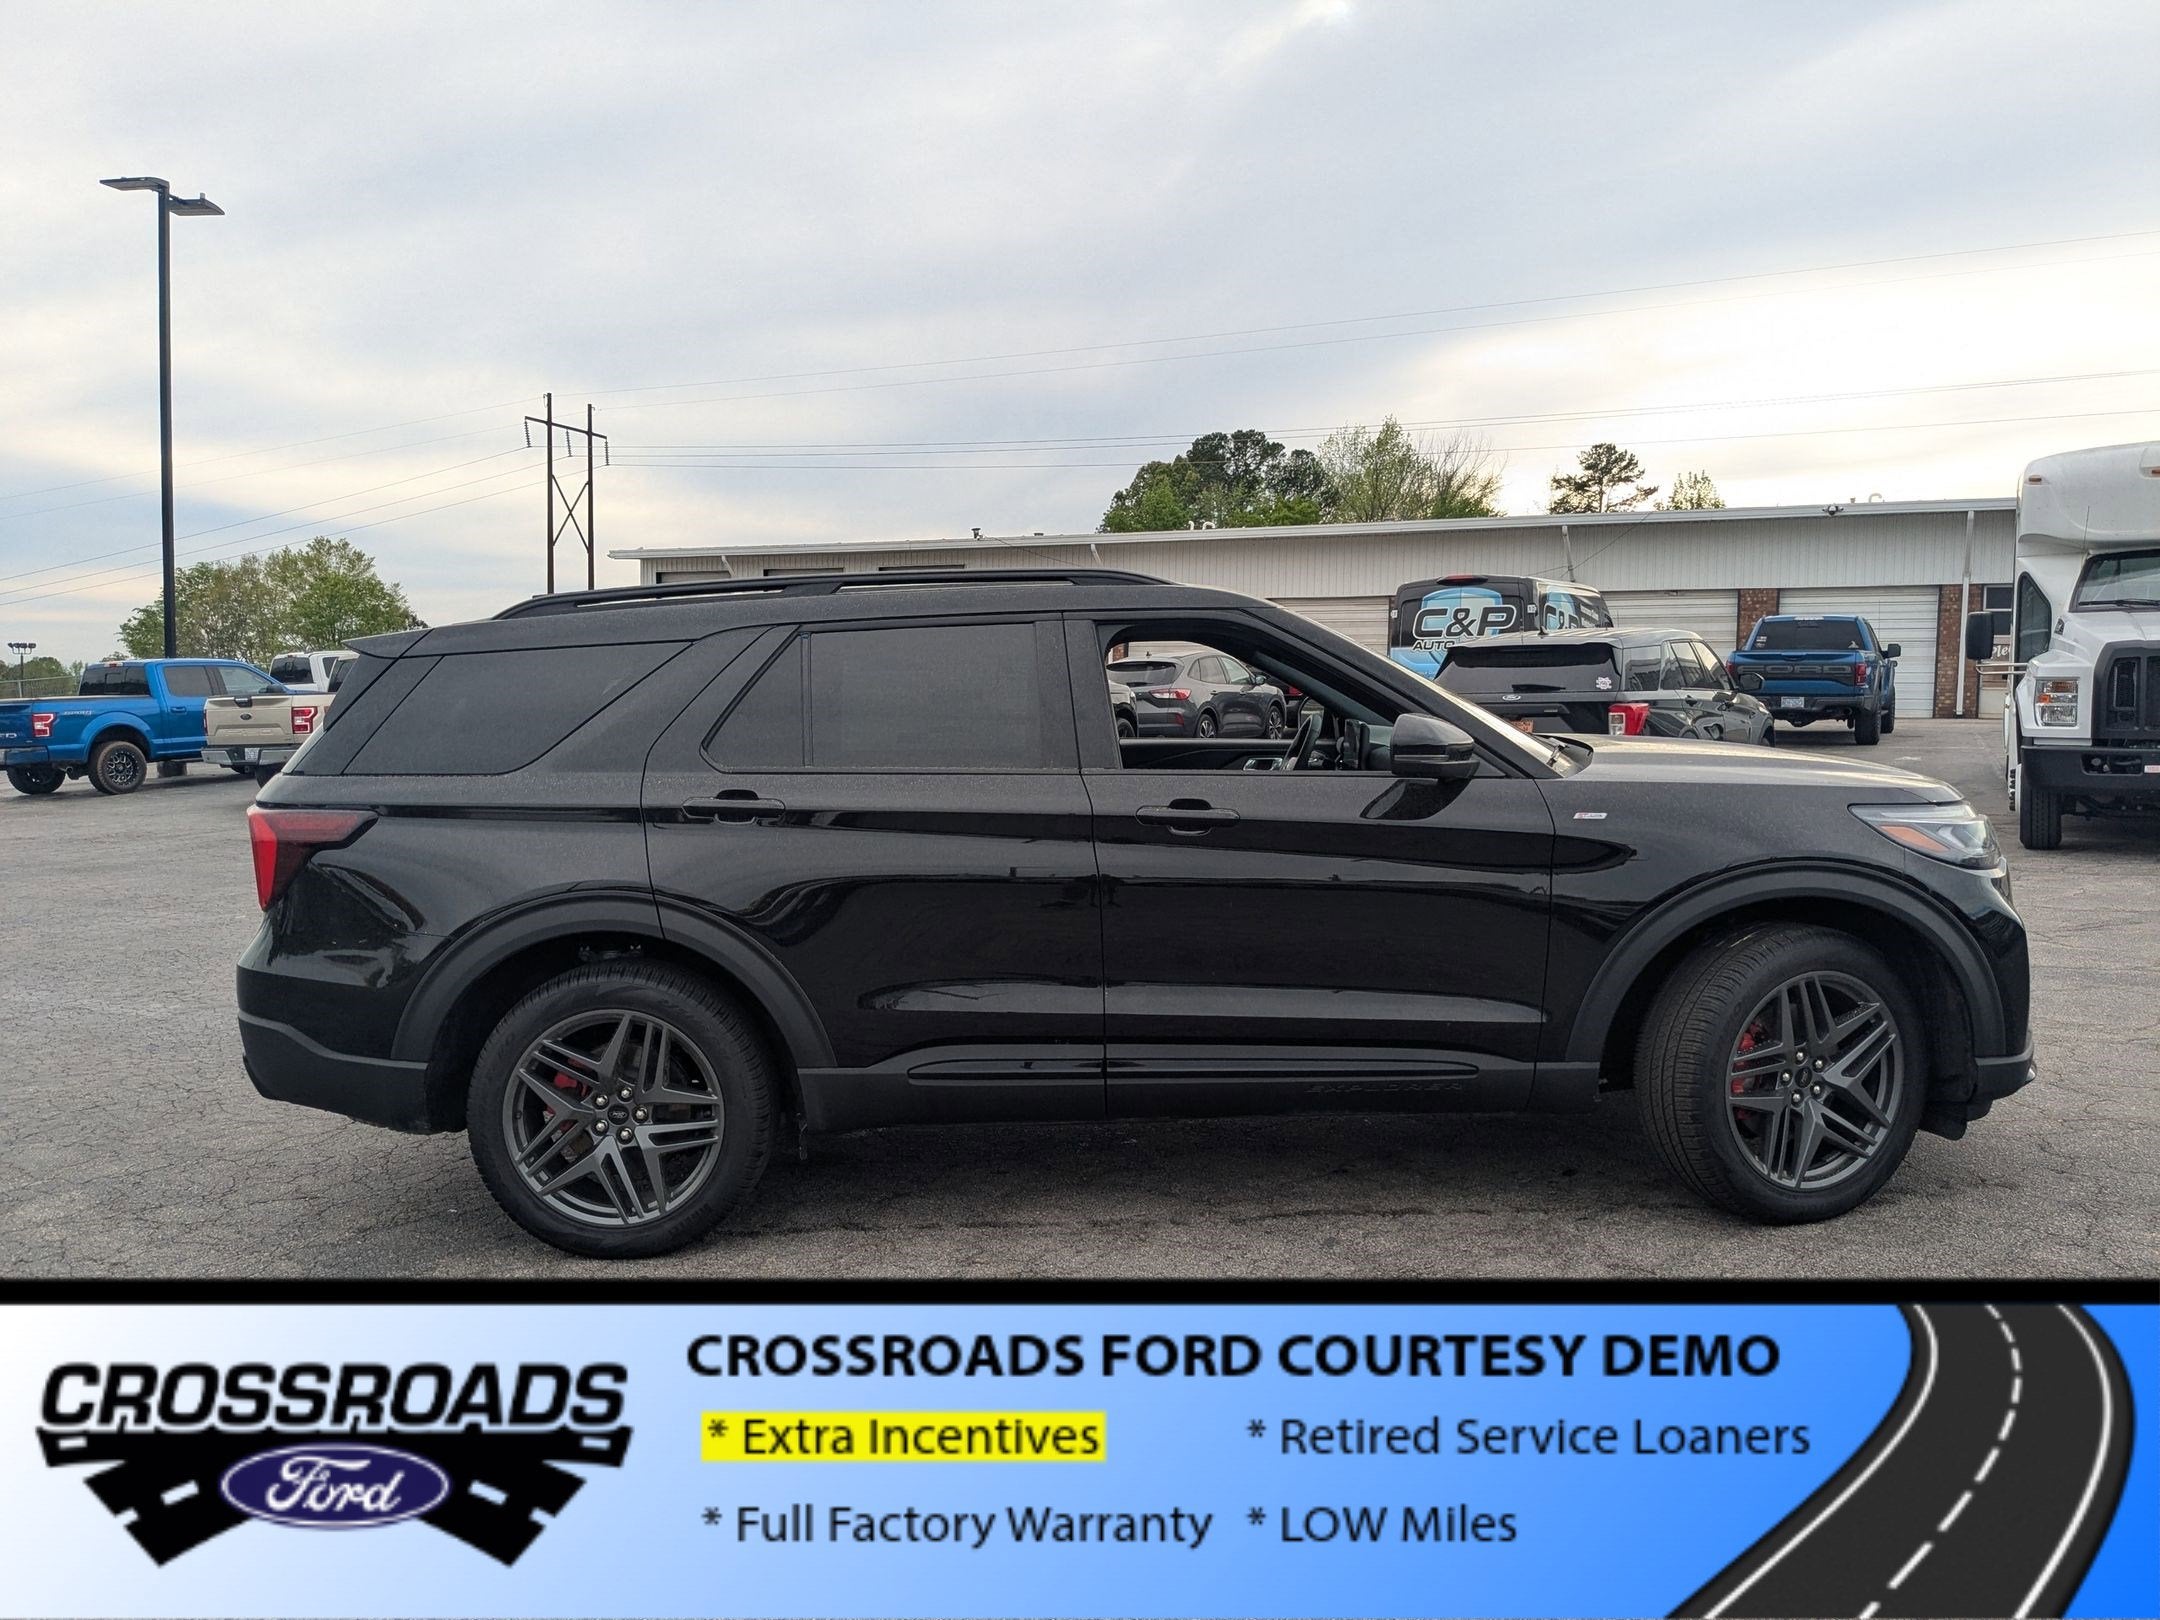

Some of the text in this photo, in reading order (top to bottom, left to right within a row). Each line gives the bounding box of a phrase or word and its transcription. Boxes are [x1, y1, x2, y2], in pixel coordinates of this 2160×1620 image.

[1412, 604, 1517, 638] C&P
[1412, 640, 1456, 651] AUTO
[1738, 665, 1851, 674] FORD
